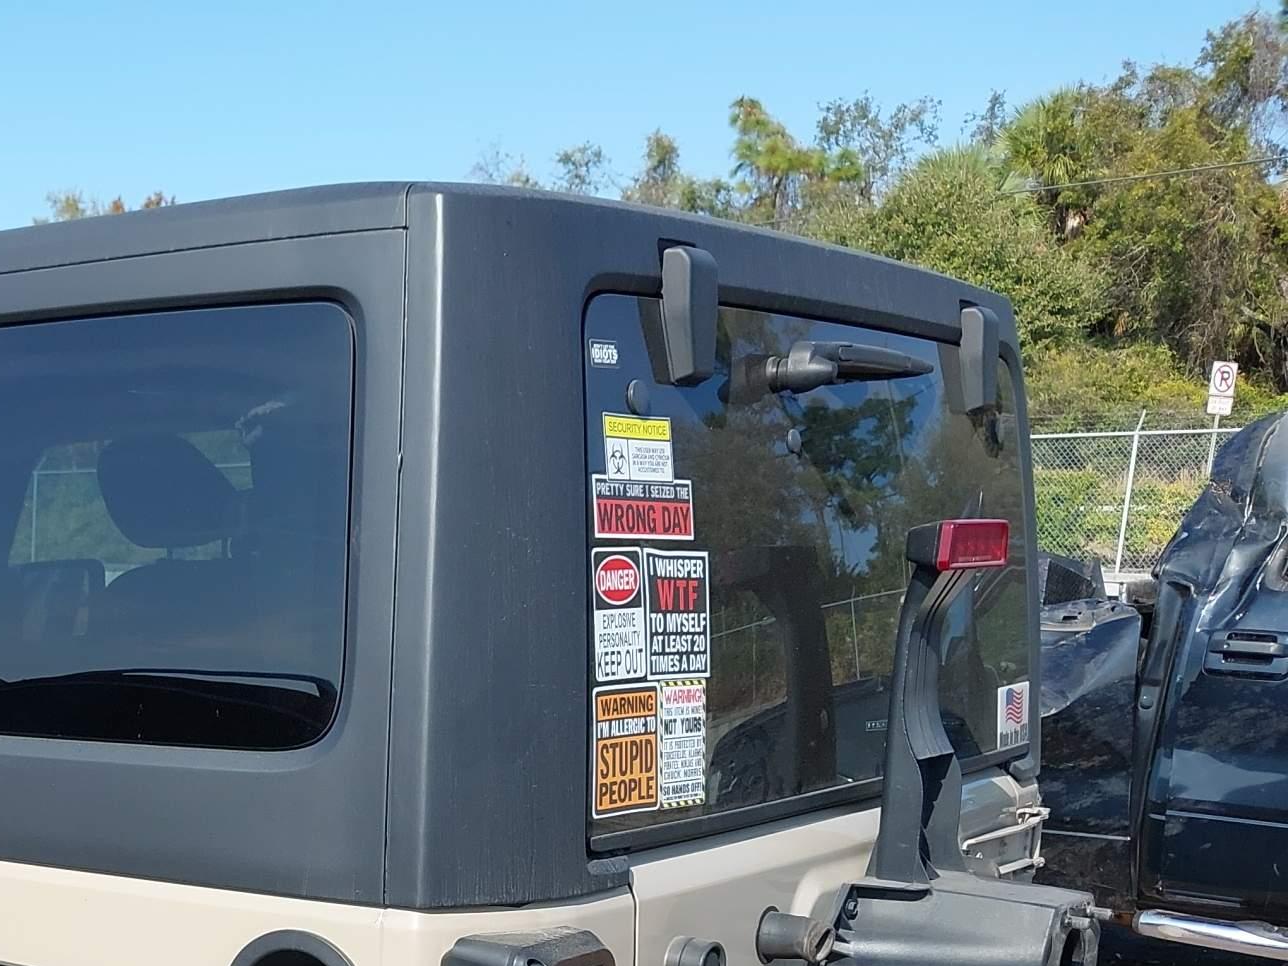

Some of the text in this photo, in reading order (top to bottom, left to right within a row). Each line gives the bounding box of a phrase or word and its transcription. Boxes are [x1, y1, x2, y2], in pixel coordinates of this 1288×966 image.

[592, 347, 618, 360] IDIOTS
[608, 421, 666, 436] SECURITY NOTICE
[596, 482, 690, 500] PRETTY SURE I SEIZED THE
[597, 503, 691, 534] WRONG DAY
[650, 557, 704, 578] I WHISPER
[600, 569, 635, 591] DANGER
[657, 579, 699, 611] WTF
[603, 612, 636, 629] EXPLOSIVE
[650, 613, 707, 633] TO MYSELF
[599, 631, 640, 649] PERSONALITY
[652, 634, 706, 653] AT LEAST 20
[597, 648, 644, 679] KEEP OUT
[651, 654, 706, 673] TIMES A DAY
[600, 694, 654, 717] WARNING
[664, 688, 702, 705] WARNING!
[598, 716, 656, 739] I'M ALLERGIC TO
[664, 716, 702, 735] NOT YOURS
[600, 738, 654, 780] STUPID
[599, 776, 655, 807] PEOPLE
[663, 785, 671, 797] SO
[672, 783, 690, 795] HANDS
